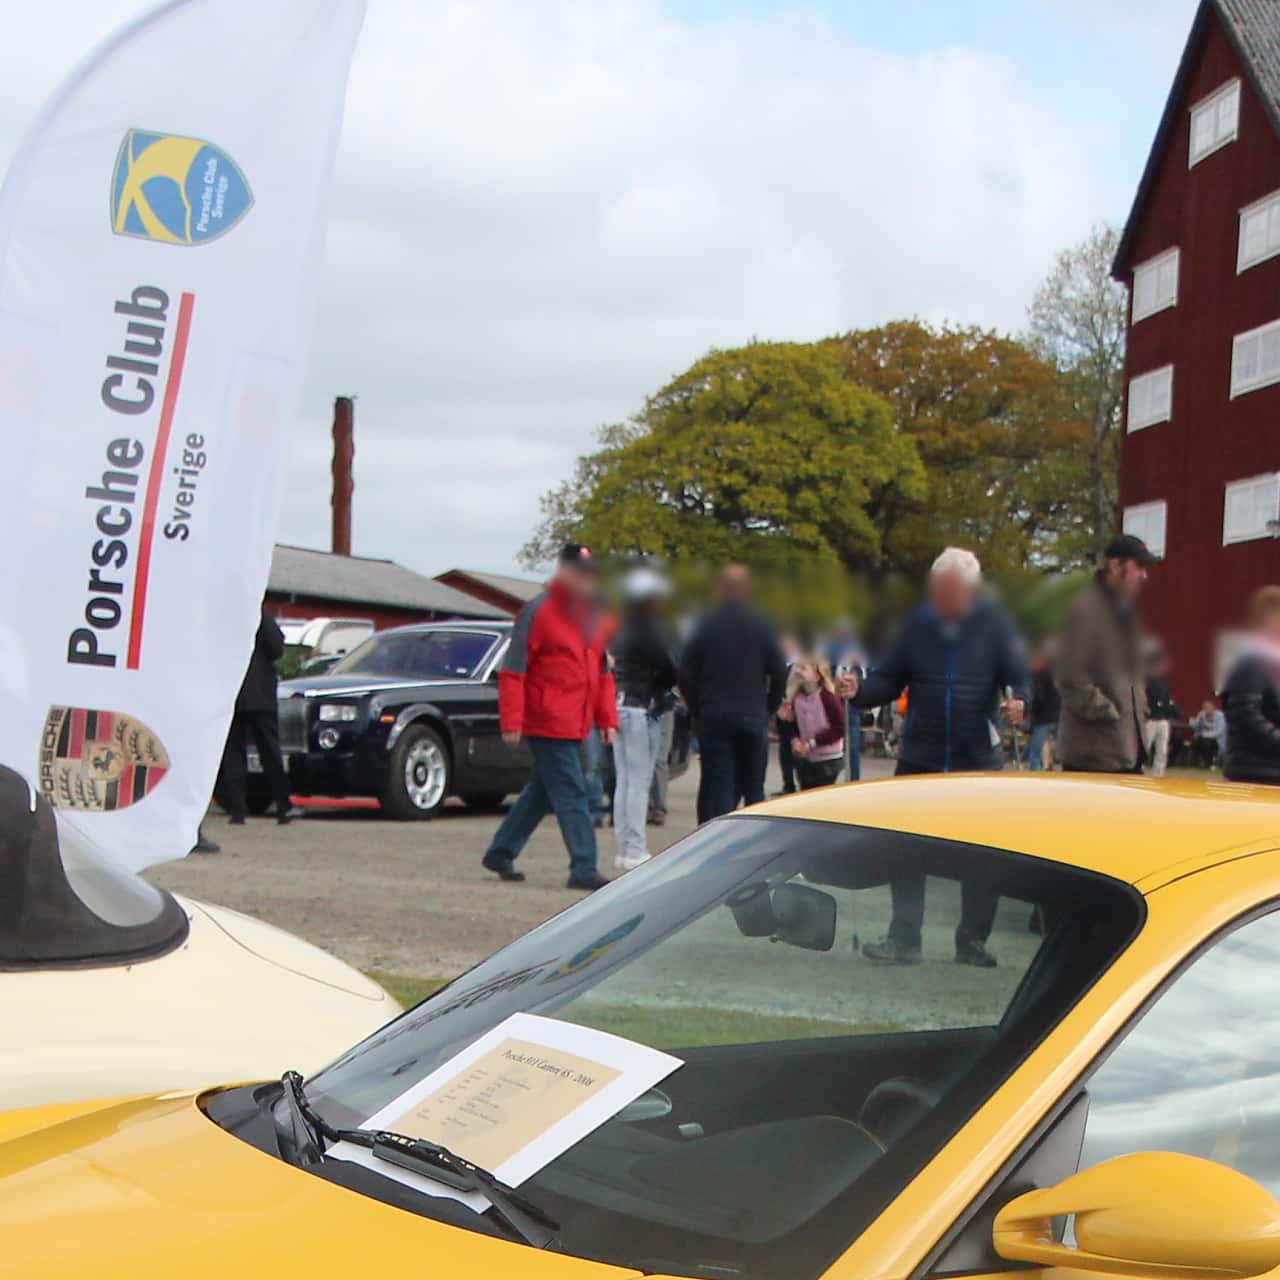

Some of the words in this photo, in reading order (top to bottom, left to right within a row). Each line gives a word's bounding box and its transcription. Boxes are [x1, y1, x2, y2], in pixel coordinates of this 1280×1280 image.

[196, 185, 214, 232] Porsche
[204, 157, 217, 184] Club
[211, 176, 228, 218] Sverige
[101, 285, 171, 416] Club
[164, 432, 207, 542] Sverige
[67, 437, 144, 668] Porsche
